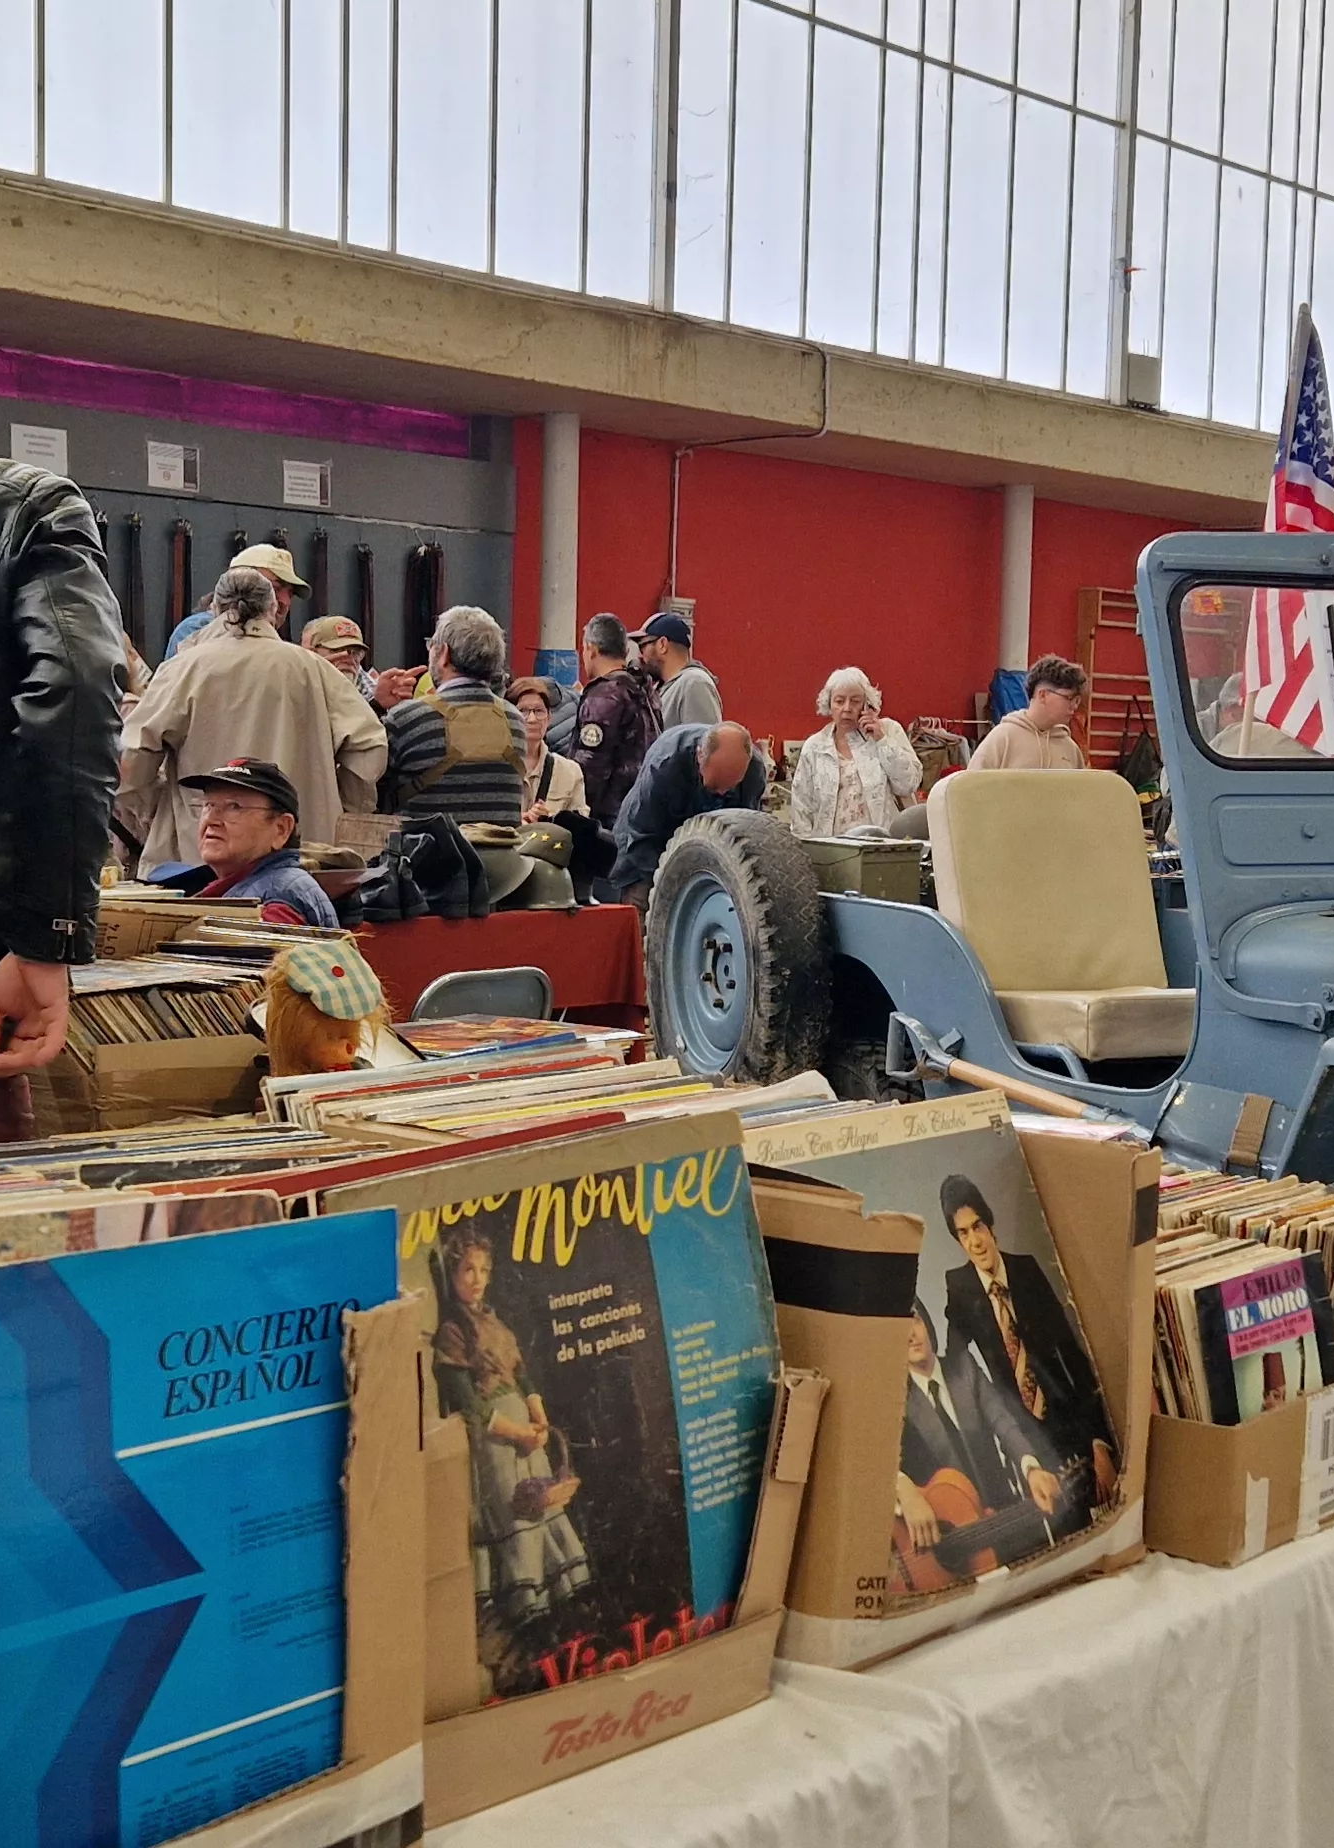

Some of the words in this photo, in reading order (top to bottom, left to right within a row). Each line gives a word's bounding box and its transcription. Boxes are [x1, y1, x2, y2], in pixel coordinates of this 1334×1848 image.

[512, 1147, 744, 1267] Montiel
[547, 1283, 613, 1310] interpreta
[1243, 1267, 1302, 1301] EMILIO
[552, 1318, 573, 1336] las
[579, 1301, 643, 1329] canciones
[1228, 1305, 1255, 1331] EL
[1258, 1287, 1310, 1323] MORO
[157, 1298, 362, 1371] CONCIERTO
[556, 1343, 575, 1363] de
[577, 1338, 593, 1357] la
[163, 1350, 323, 1419] ESPAÑOL
[855, 1595, 874, 1609] PO
